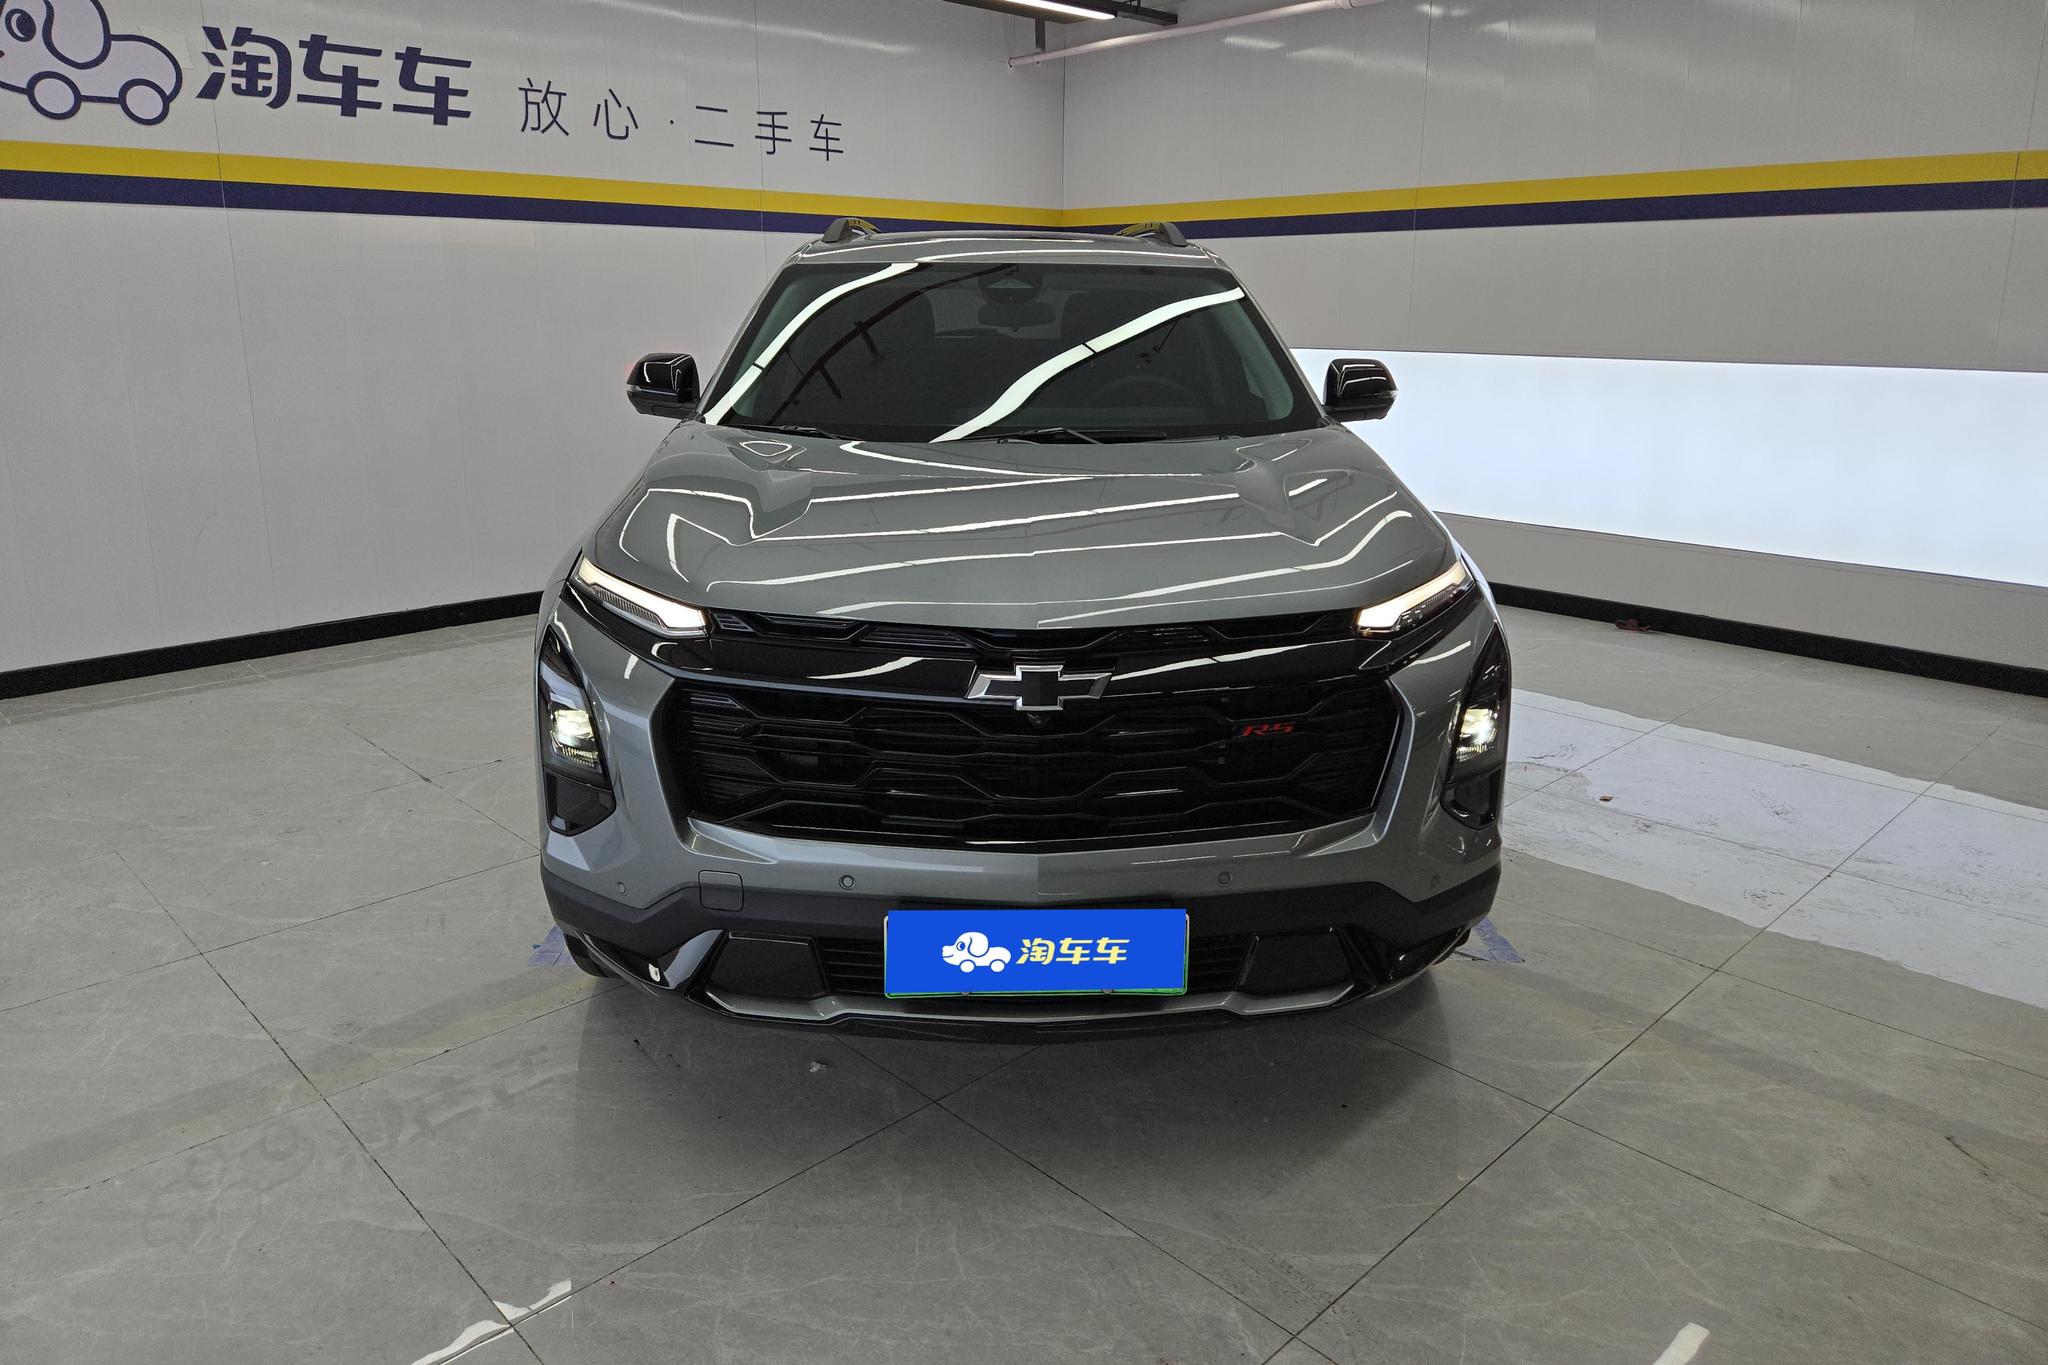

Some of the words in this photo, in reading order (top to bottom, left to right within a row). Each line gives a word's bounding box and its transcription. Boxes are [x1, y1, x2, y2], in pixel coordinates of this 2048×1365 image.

[195, 25, 472, 126] 淘车车
[1242, 722, 1295, 737] RS
